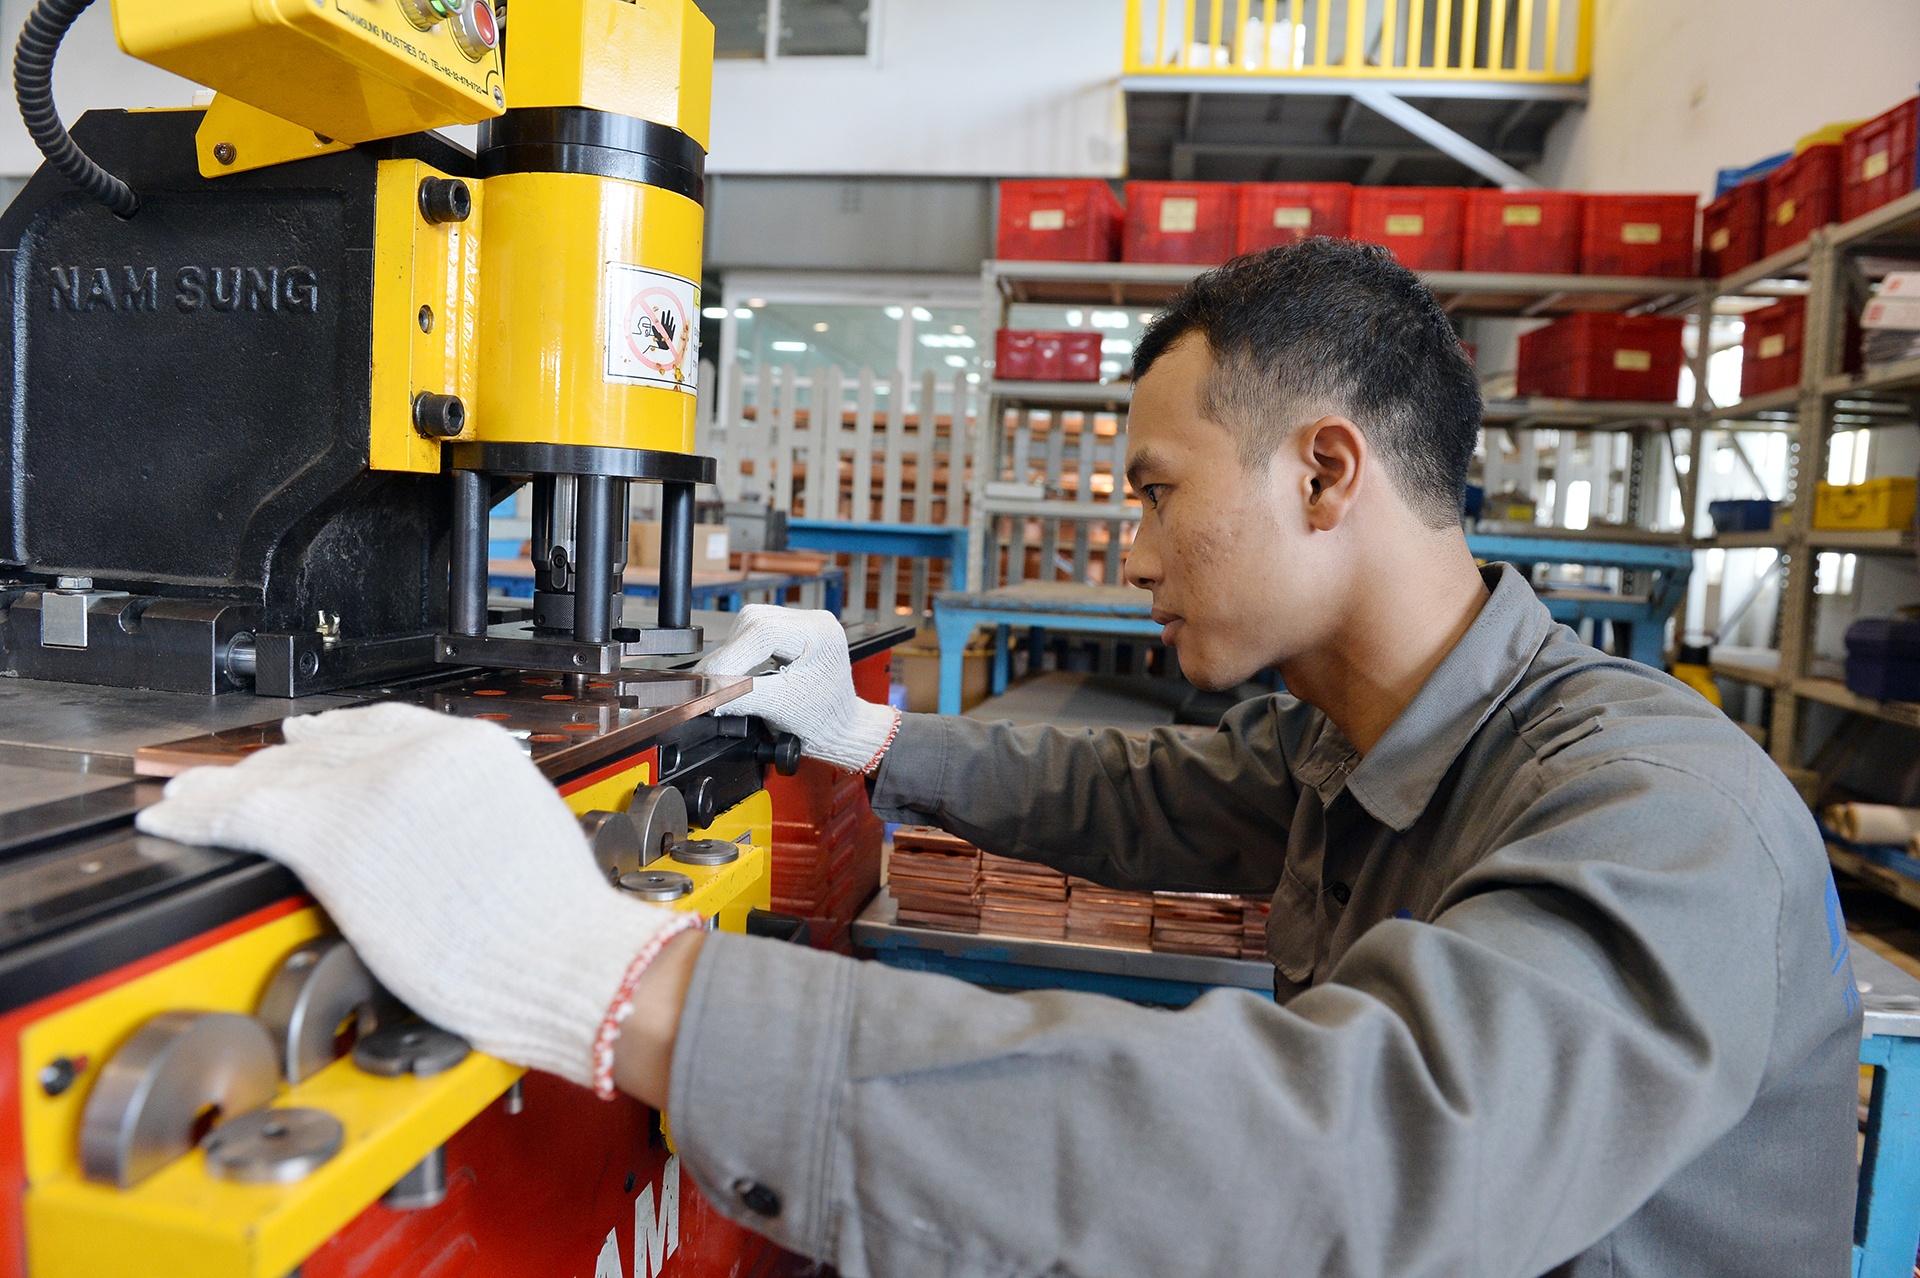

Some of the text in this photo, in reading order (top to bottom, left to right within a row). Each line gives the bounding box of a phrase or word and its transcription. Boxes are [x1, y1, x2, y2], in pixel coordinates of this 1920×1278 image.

[381, 28, 417, 57] INDUSTRIES
[49, 264, 318, 314] NAM SUNG
[573, 1153, 680, 1278] AM
